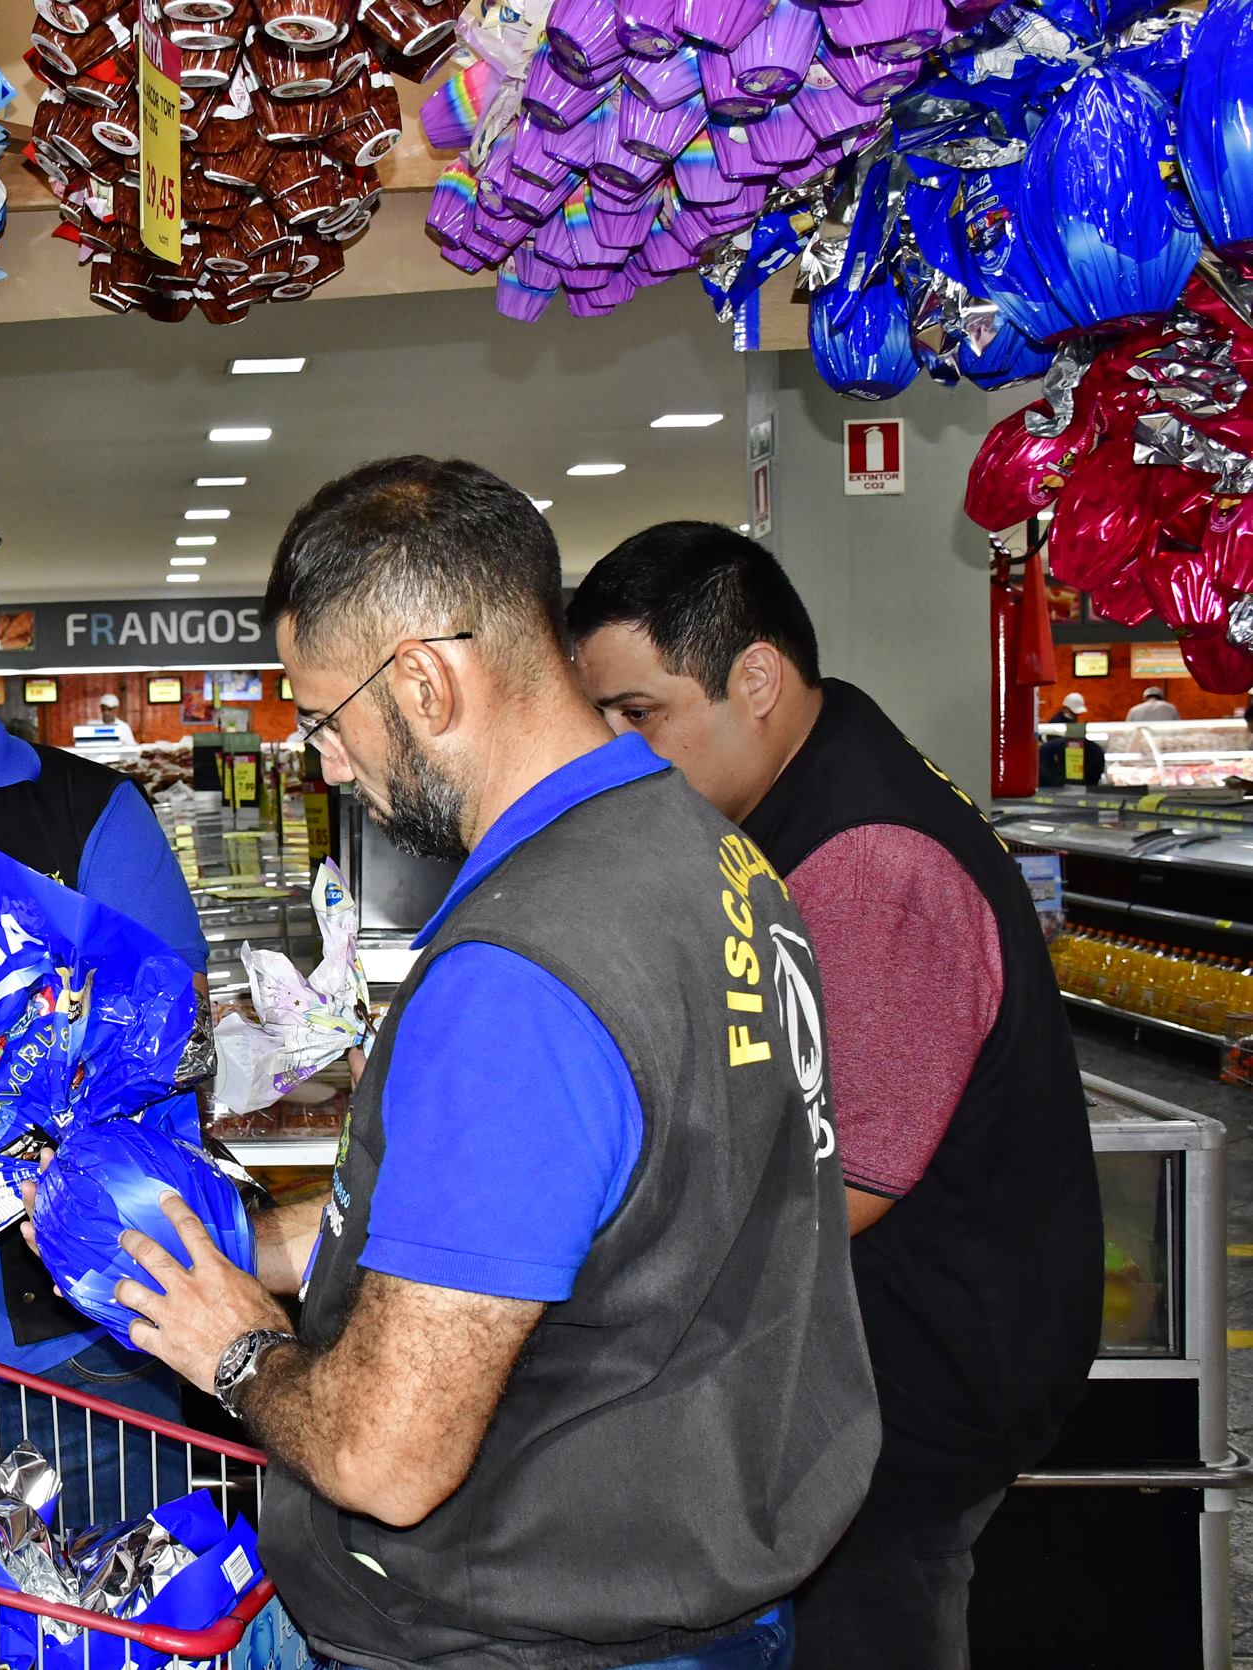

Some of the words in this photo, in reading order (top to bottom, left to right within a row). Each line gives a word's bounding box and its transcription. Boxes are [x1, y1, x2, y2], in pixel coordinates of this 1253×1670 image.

[147, 161, 176, 220] 29,45
[967, 173, 992, 200] ACTA
[848, 473, 899, 482] EXTINTOR
[864, 482, 885, 490] CO2
[66, 608, 261, 647] FRANGOS
[719, 834, 789, 1068] FISCALIZA
